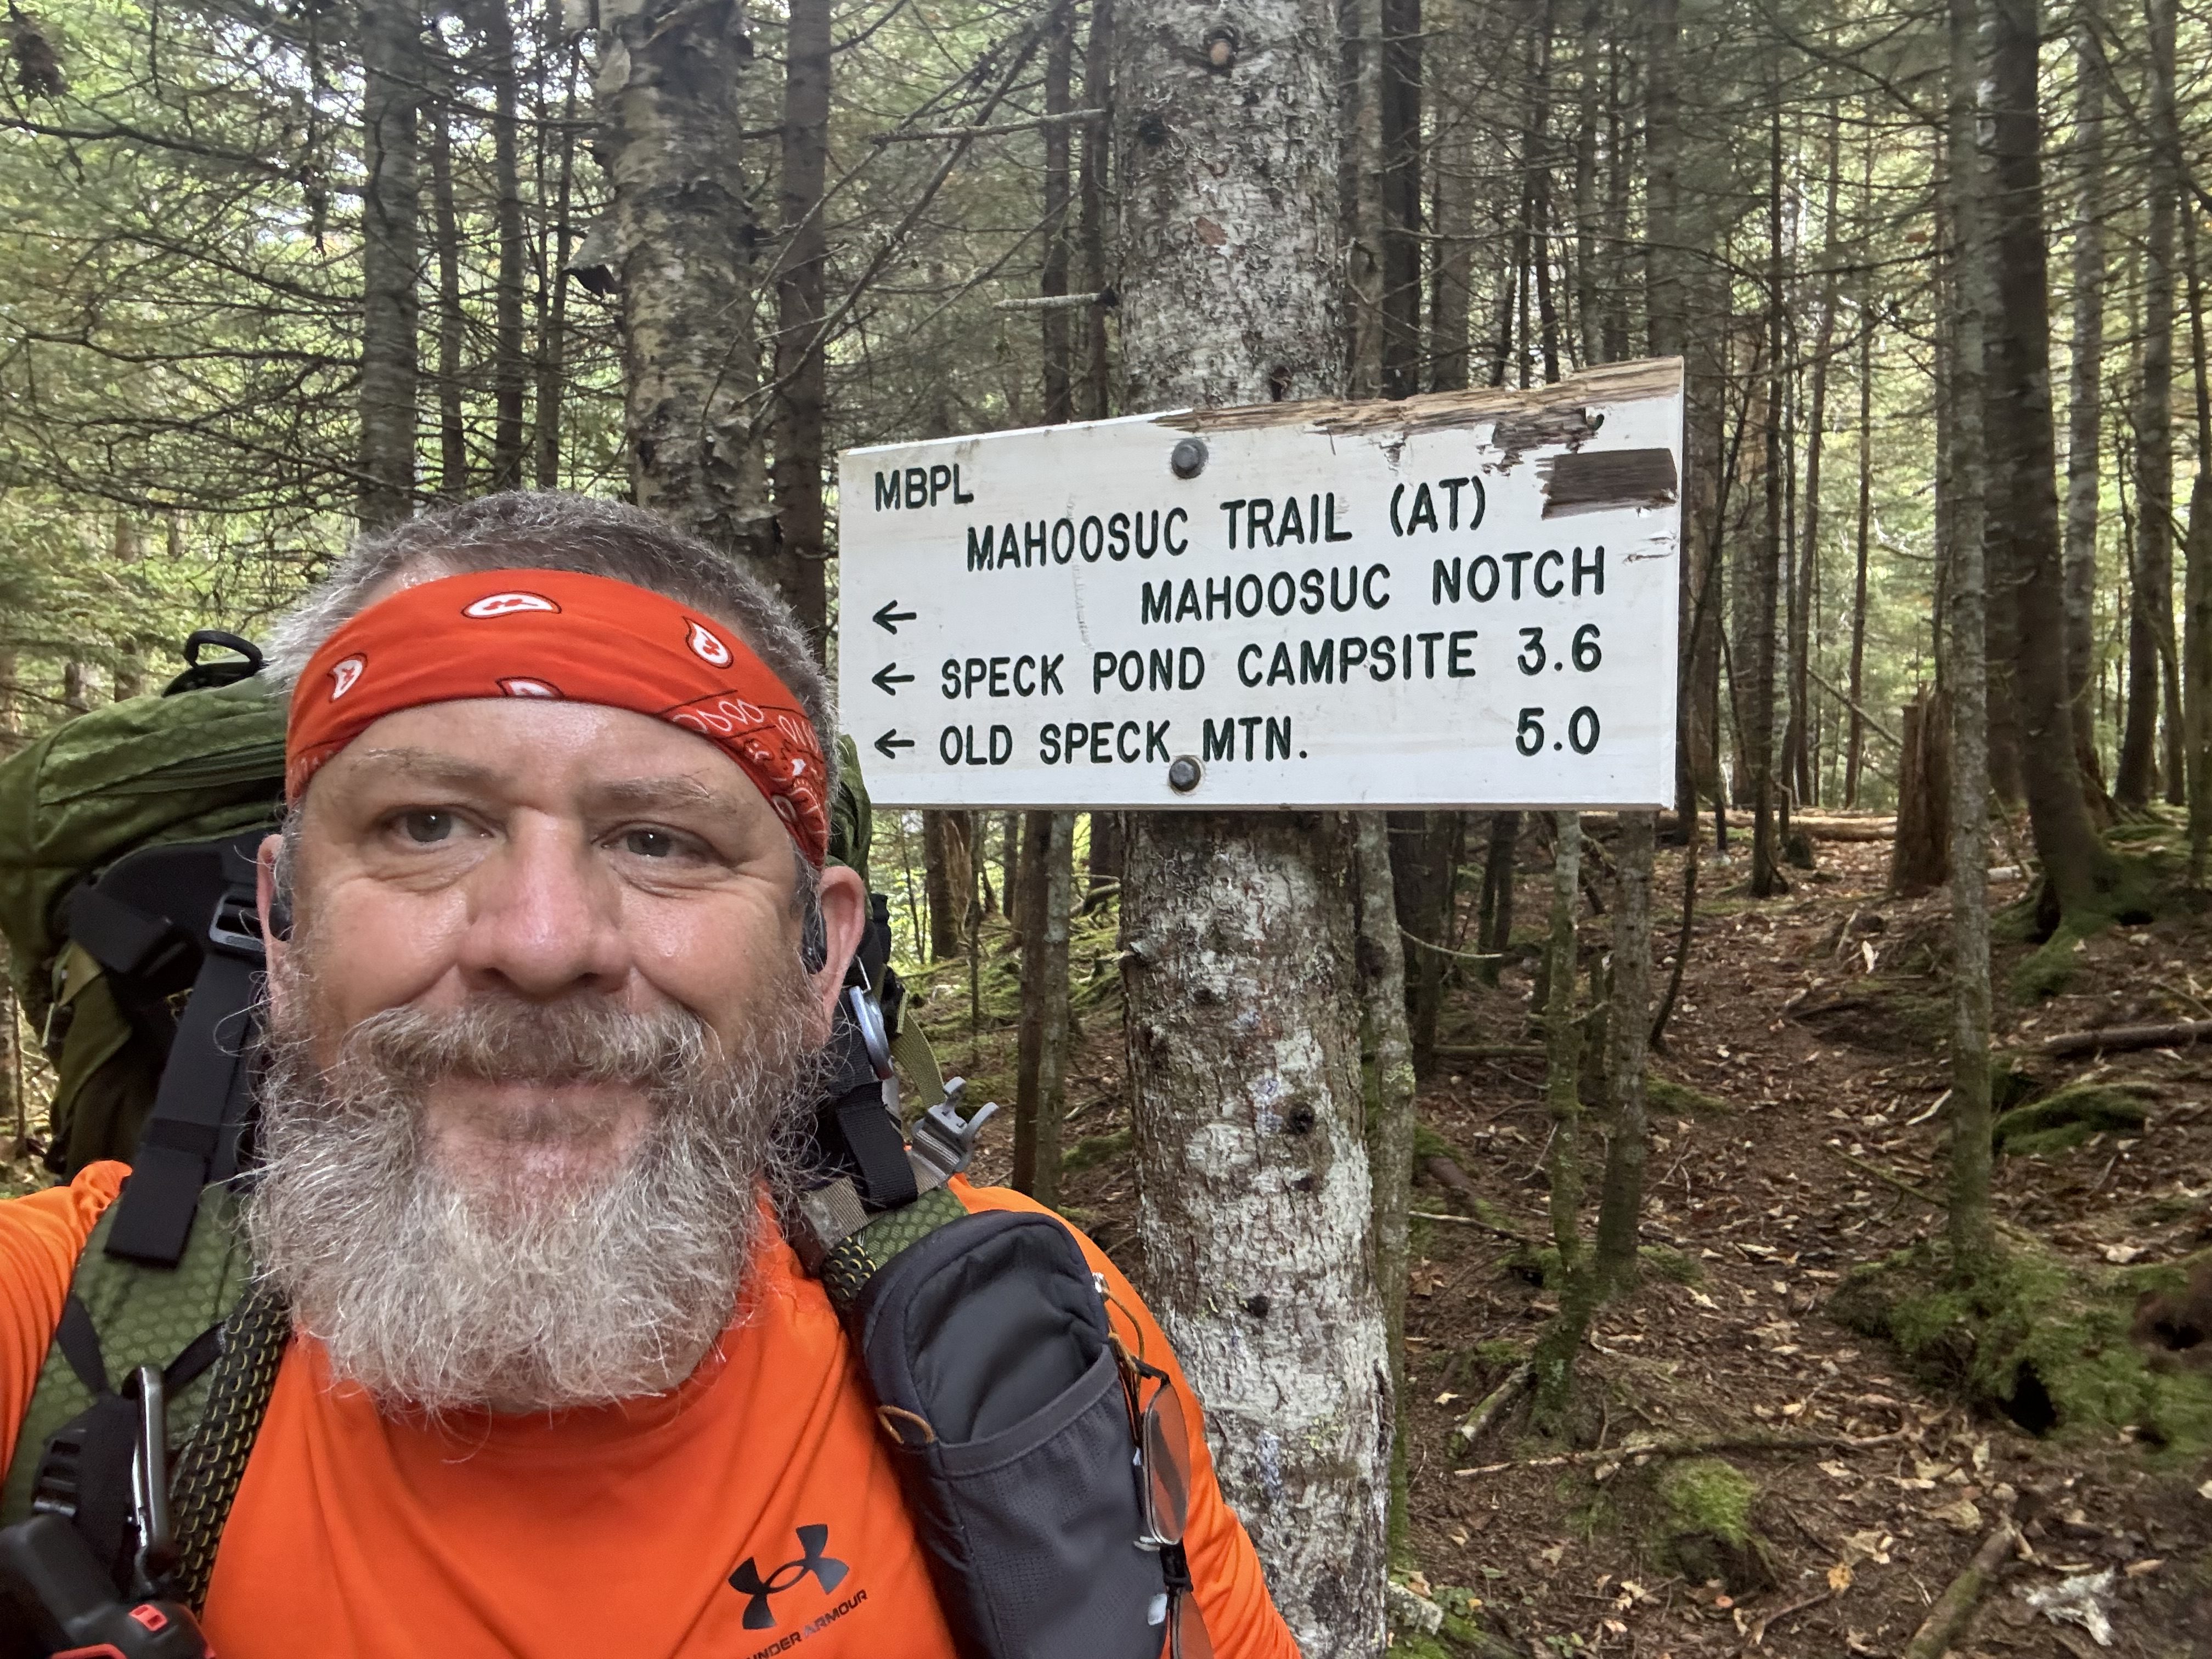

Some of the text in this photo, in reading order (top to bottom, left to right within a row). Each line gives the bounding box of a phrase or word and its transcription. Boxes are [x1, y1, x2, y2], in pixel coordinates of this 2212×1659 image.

[876, 464, 974, 511] MBPL
[968, 476, 1485, 571] MAHOOSUC TRAIL (AT)
[1142, 546, 1604, 624] MAHOOSUC NOTCH
[942, 624, 1601, 699] SPECK POND CAMPSITE 3.6
[940, 706, 1600, 765] OLD SPECK MTN. 5.0
[803, 1589, 868, 1638] ARMOUR
